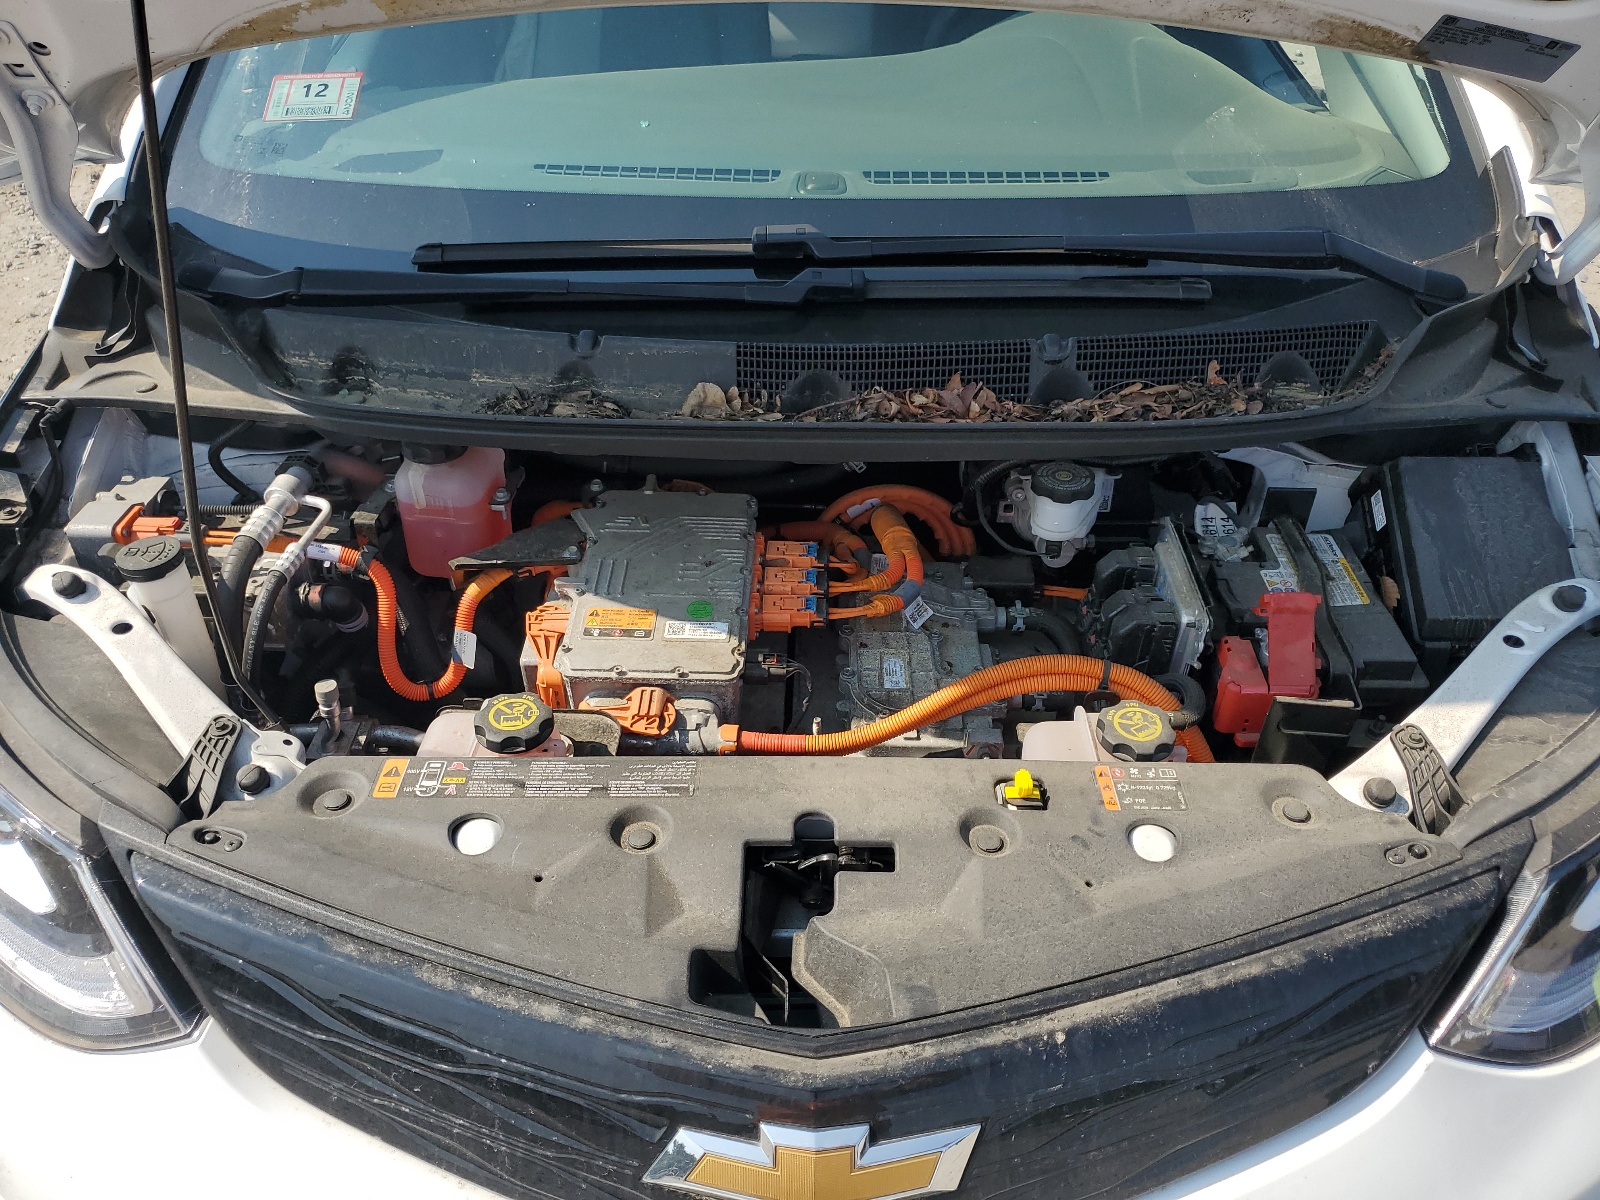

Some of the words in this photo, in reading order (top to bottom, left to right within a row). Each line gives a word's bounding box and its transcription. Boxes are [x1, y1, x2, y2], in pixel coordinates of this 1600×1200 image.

[303, 83, 330, 98] 12
[1201, 517, 1217, 537] 614
[1220, 516, 1235, 537] 614
